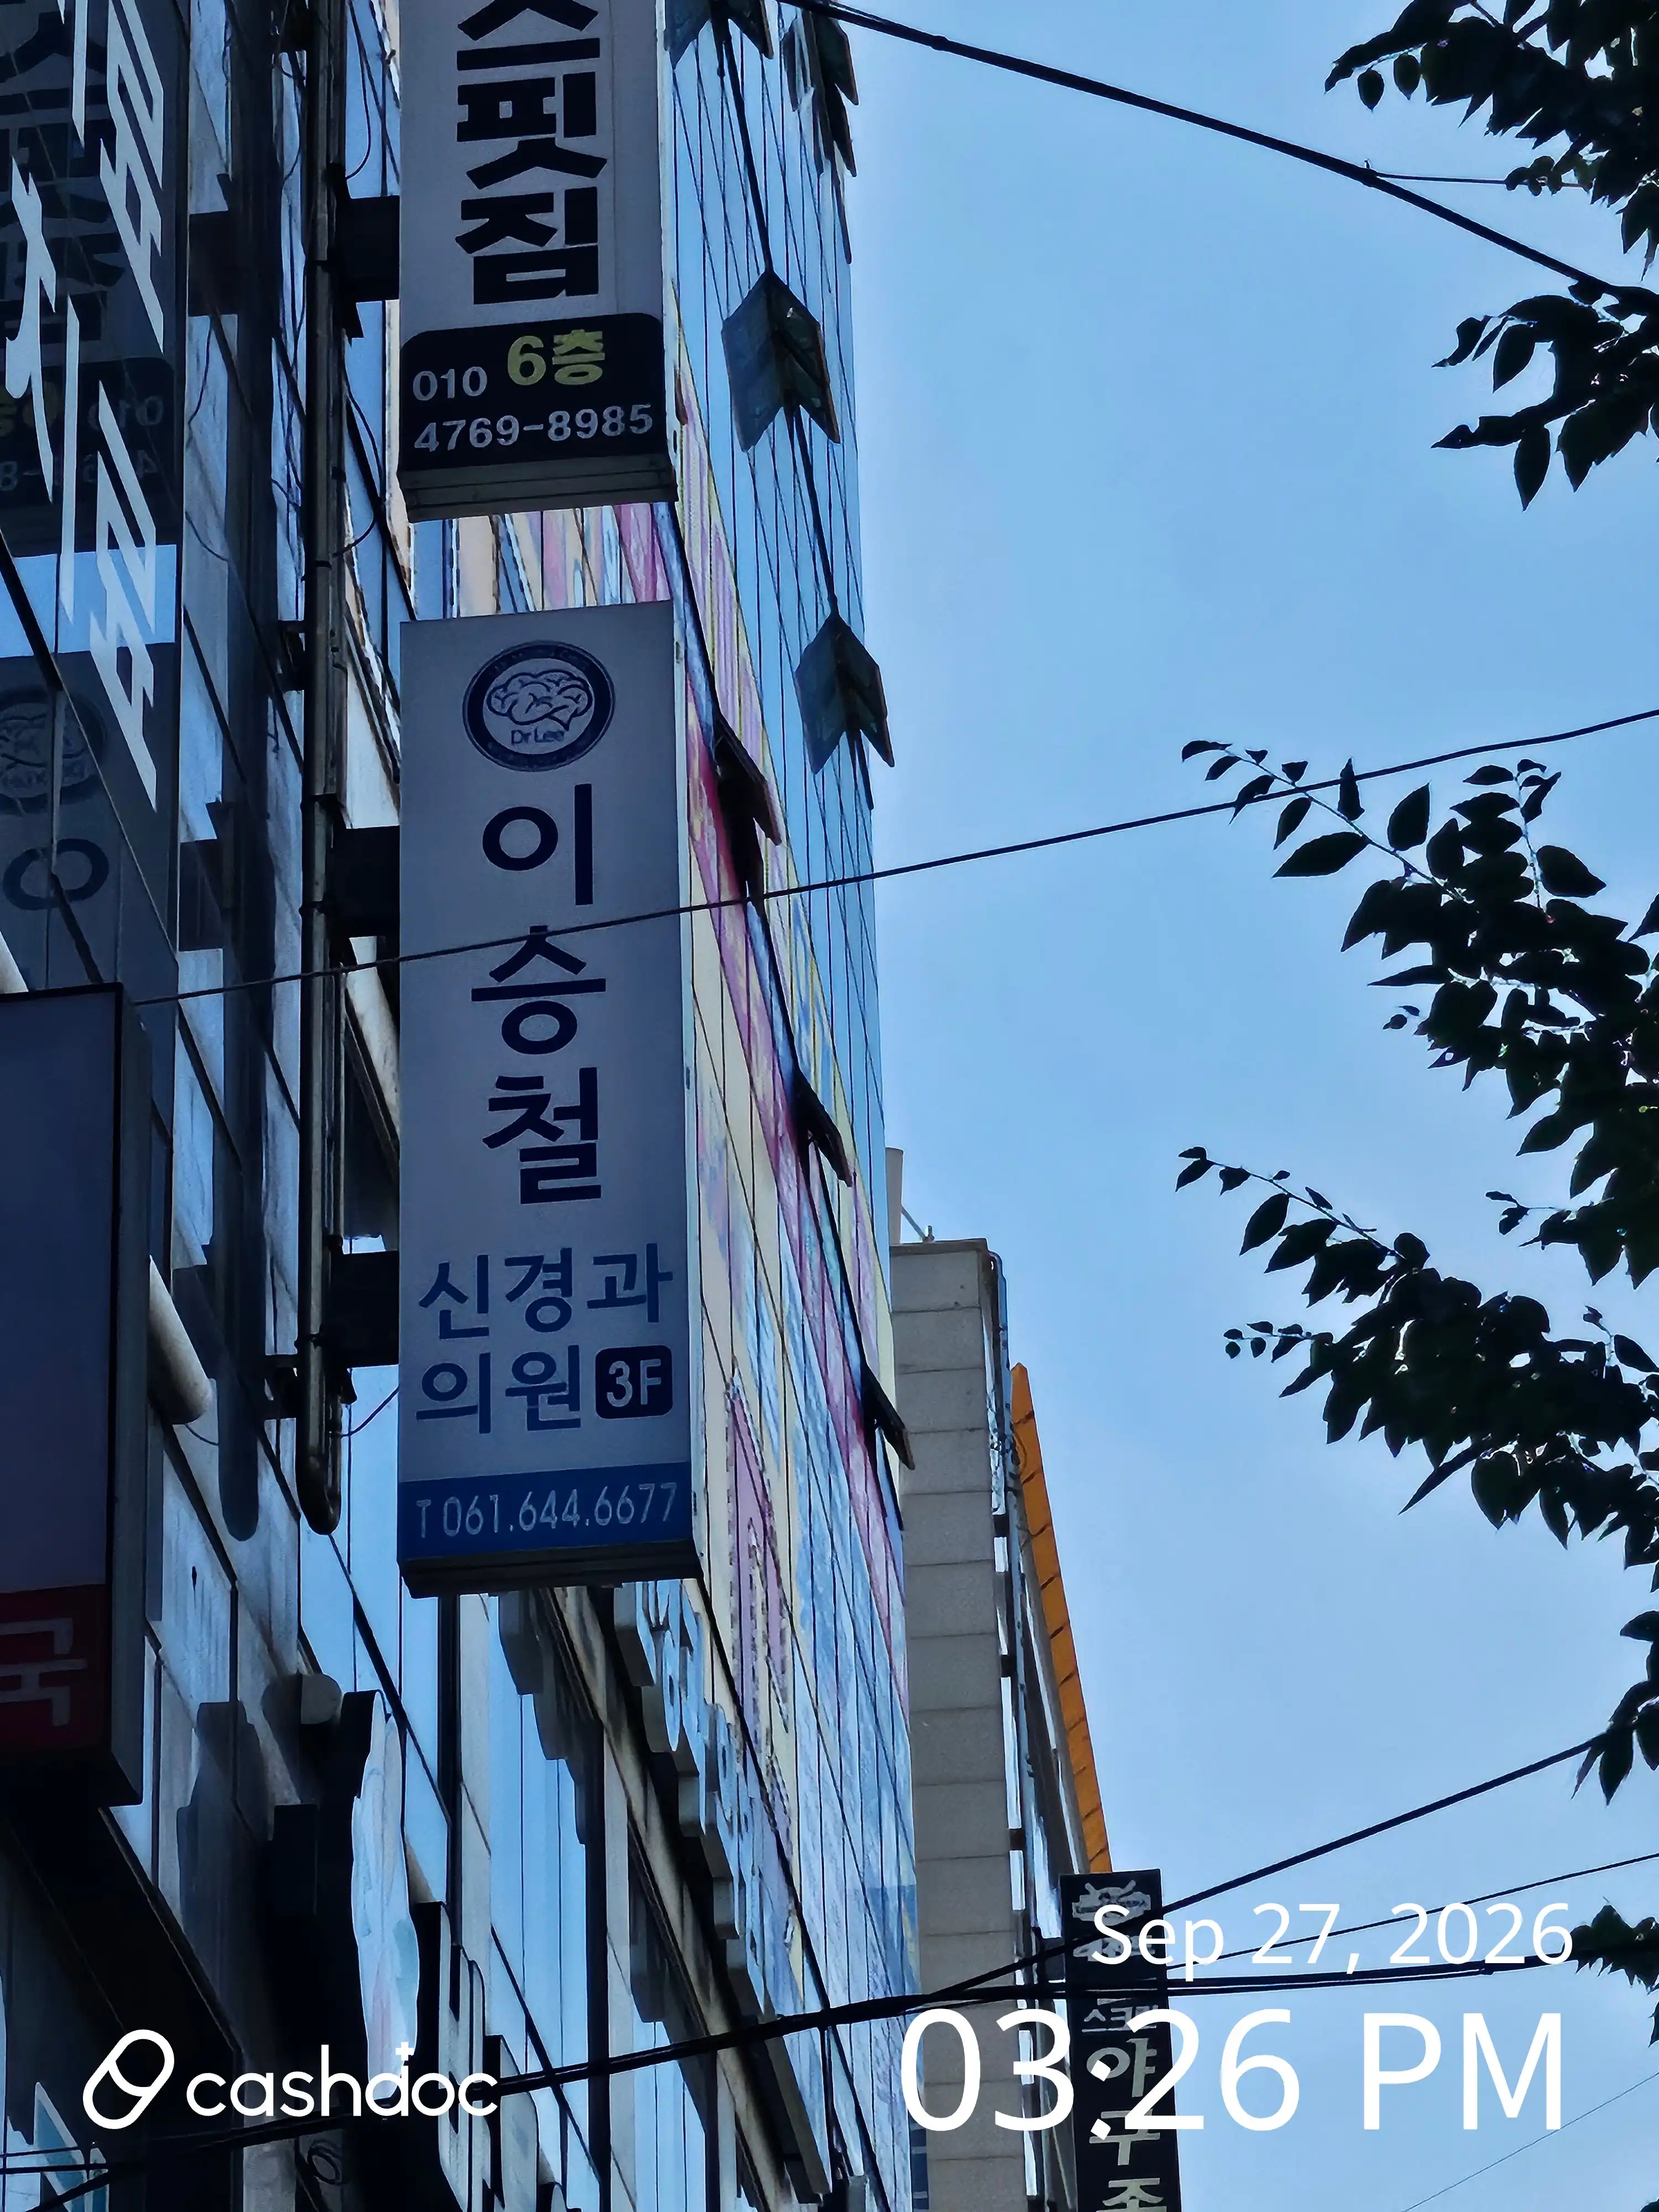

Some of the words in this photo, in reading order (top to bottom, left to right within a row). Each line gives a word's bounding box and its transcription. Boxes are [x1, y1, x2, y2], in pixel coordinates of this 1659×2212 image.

[413, 366, 488, 402] 010
[507, 329, 605, 387] 6층
[413, 404, 653, 453] 4769-8985
[471, 783, 606, 1204] 이승철
[418, 1243, 674, 1340] 신경과
[416, 1344, 581, 1434] 의원
[606, 1358, 662, 1407] 3F
[416, 1499, 432, 1538] T
[443, 1482, 677, 1537] 061.644.6677
